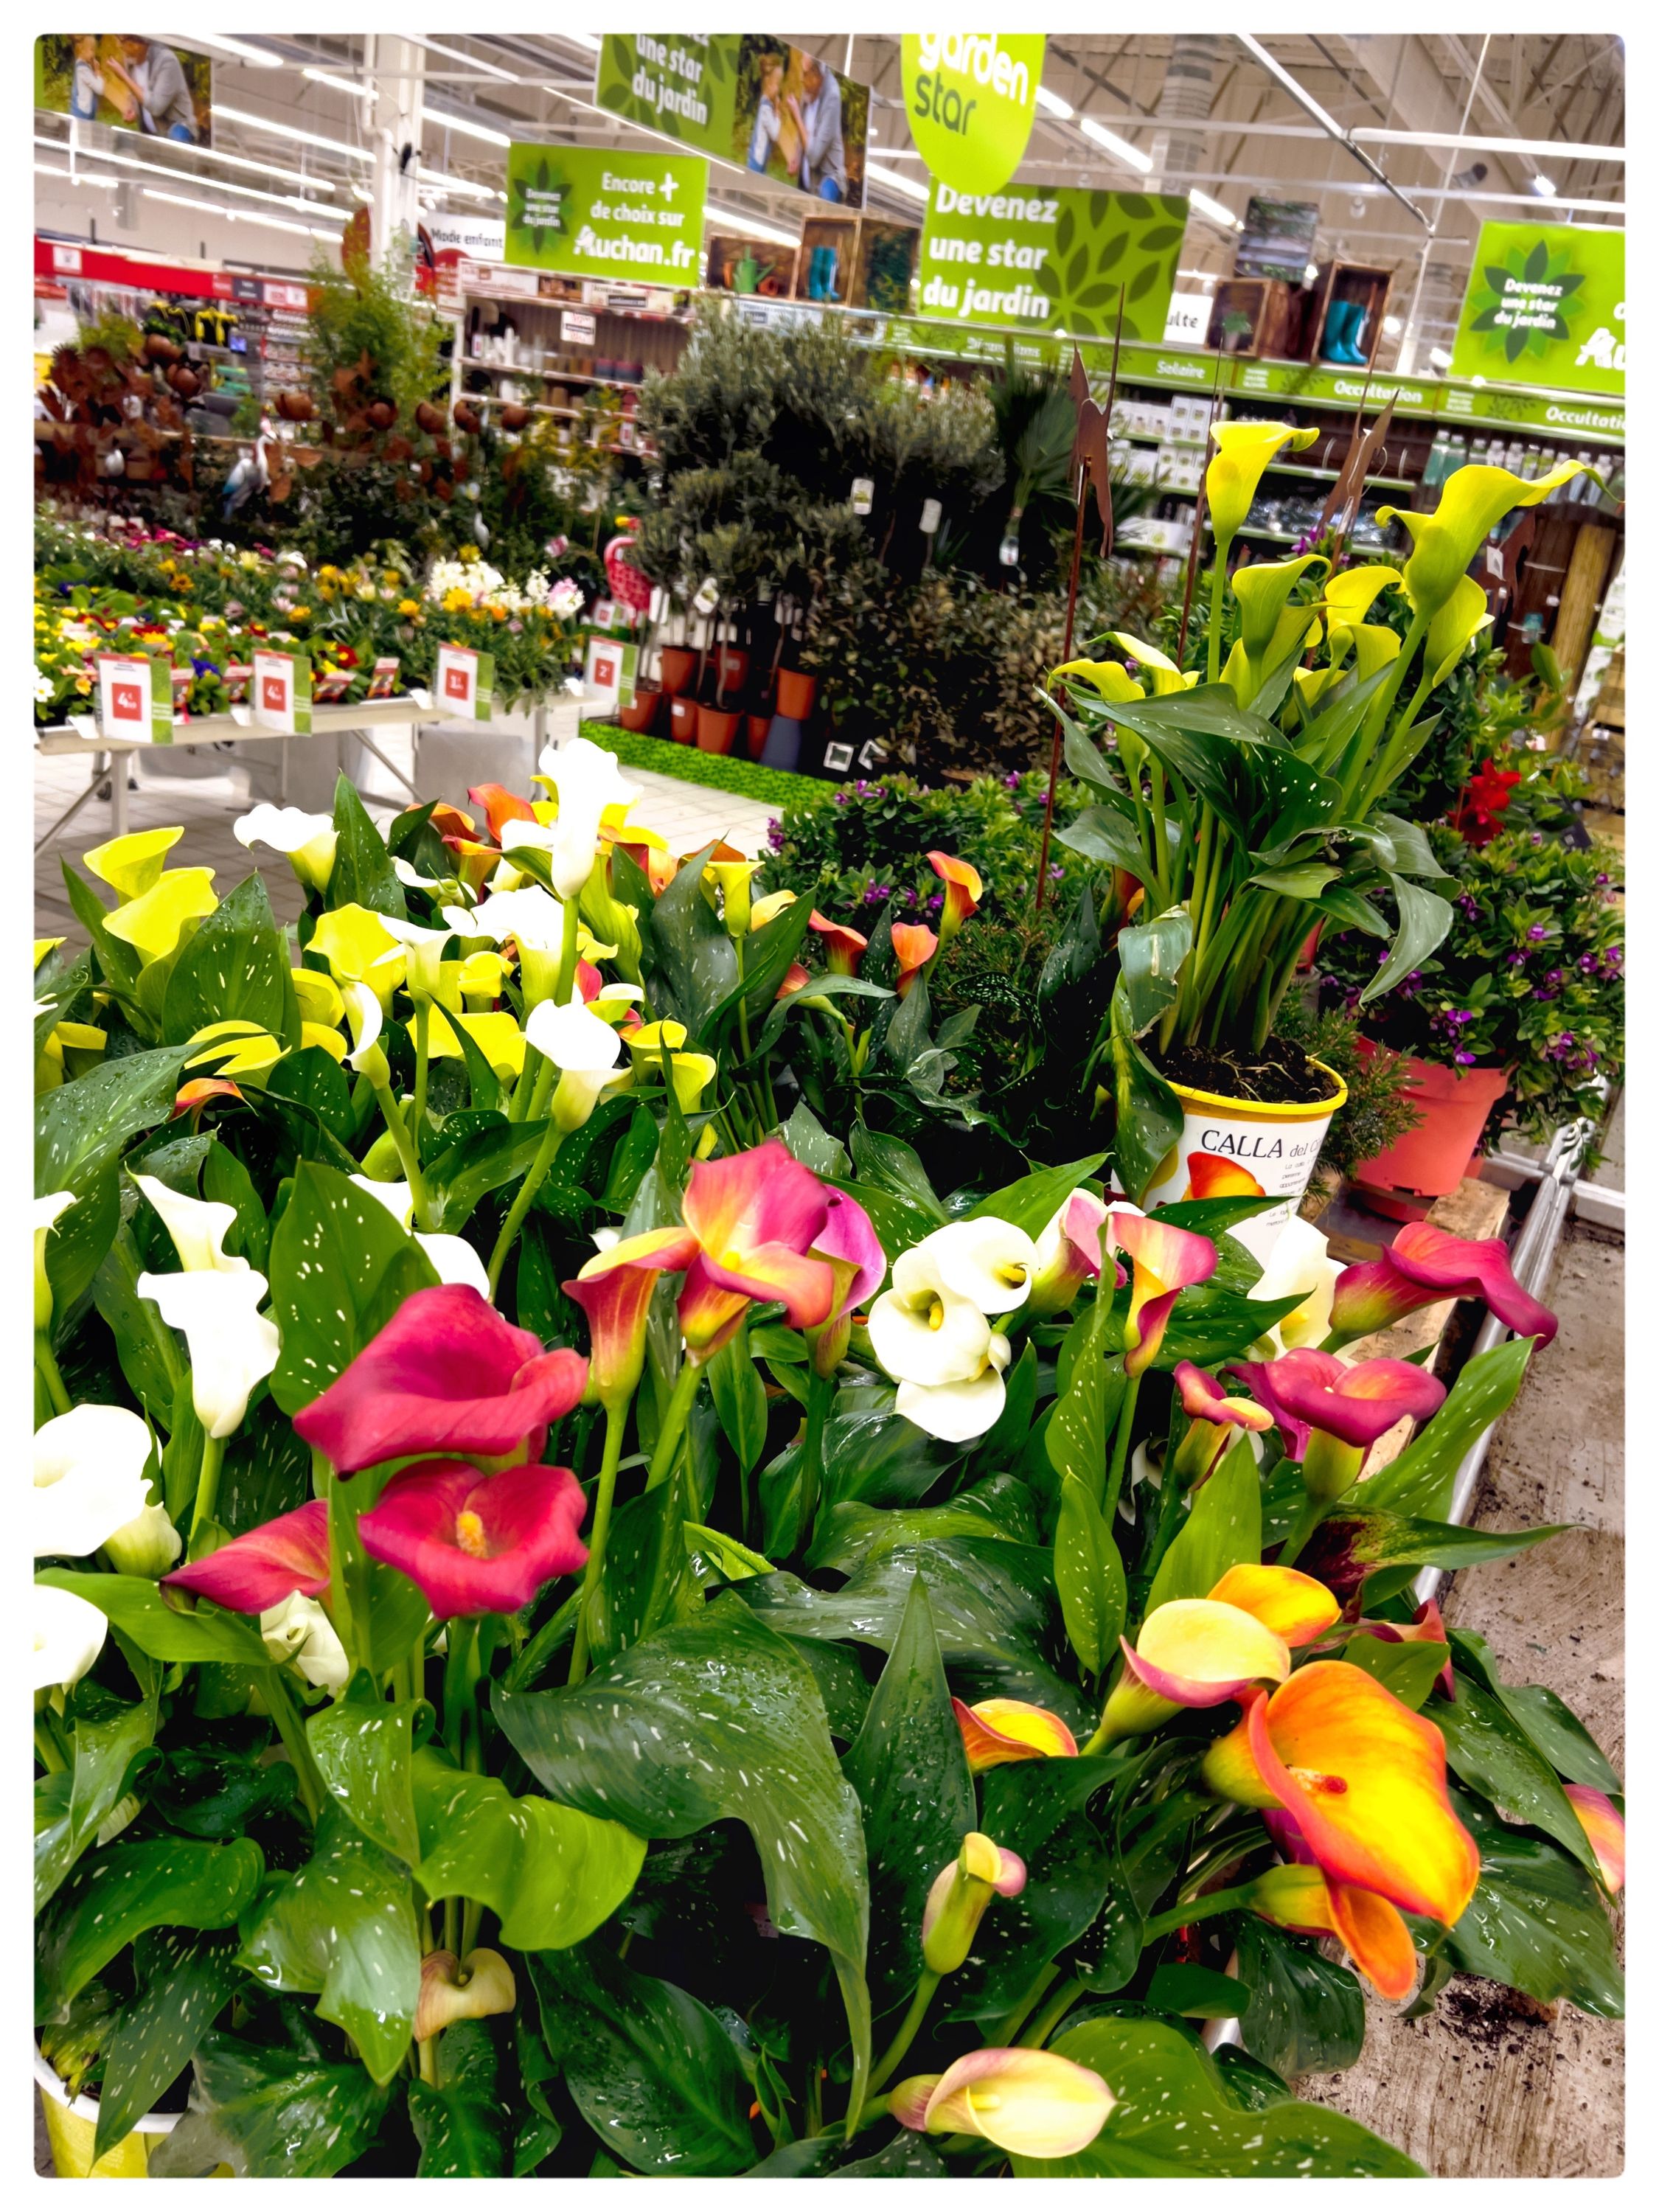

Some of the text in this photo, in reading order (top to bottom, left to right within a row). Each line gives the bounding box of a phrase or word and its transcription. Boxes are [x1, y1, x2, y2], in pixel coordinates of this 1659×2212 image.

[636, 34, 703, 83] une star
[919, 34, 1029, 106] garden
[632, 66, 708, 125] du jardin
[914, 72, 976, 136] star
[602, 172, 655, 195] Encore
[591, 200, 685, 227] de choix sur
[935, 183, 1060, 223] Devenez
[431, 228, 504, 248] Mode enfant
[573, 225, 695, 268] Auchan.fr
[929, 237, 1048, 271] une star
[923, 276, 1051, 319] du jardin
[1504, 277, 1563, 296] Devenez
[1500, 297, 1559, 313] une star
[1494, 310, 1557, 330] du jardin
[1156, 359, 1206, 379] Solaire
[1333, 380, 1423, 403] Occultation
[1201, 1130, 1283, 1158] CALLA
[1290, 1143, 1308, 1158] del
